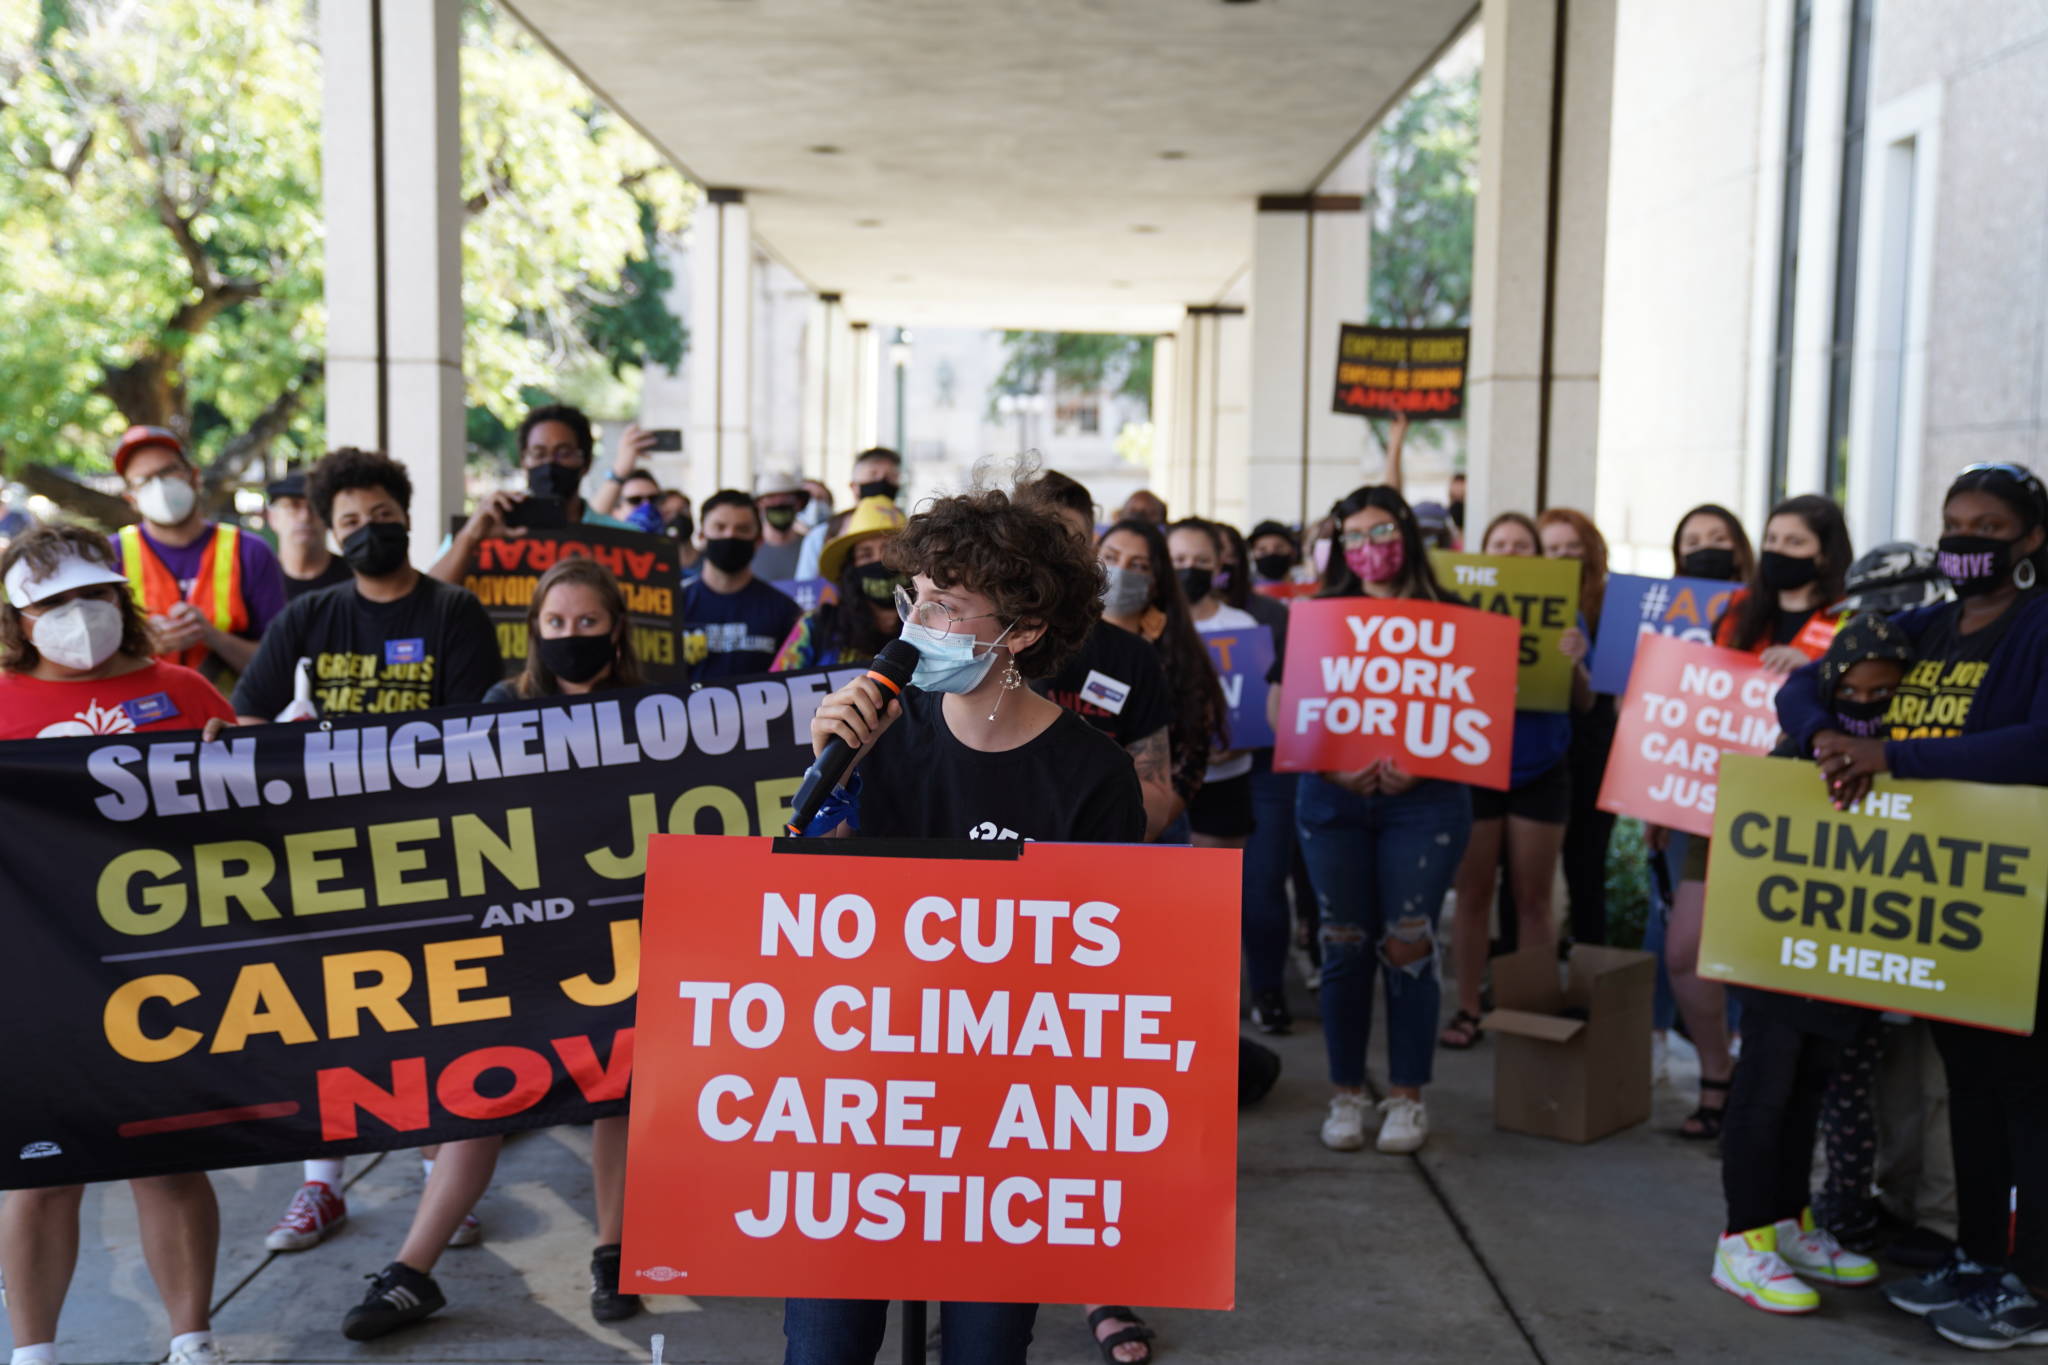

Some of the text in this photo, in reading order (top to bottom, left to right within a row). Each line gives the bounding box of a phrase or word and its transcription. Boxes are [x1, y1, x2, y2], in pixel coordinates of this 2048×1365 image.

[1454, 565, 1498, 586] THE
[1346, 615, 1456, 658] YOU
[1320, 656, 1476, 704] WORK
[1642, 692, 1688, 728] TO
[1679, 664, 1733, 699] NO
[1296, 697, 1492, 766] FOR US
[1641, 732, 1722, 775] CAR
[87, 737, 292, 821] SEN.
[97, 807, 541, 936] GREEN
[1729, 811, 2031, 897] CLIMATE
[480, 898, 575, 929] AND
[760, 892, 1122, 967] NO CUTS
[1757, 875, 1984, 953] CRISIS
[103, 936, 512, 1064] CARE
[1780, 936, 1946, 992] IS HERE.
[679, 981, 1197, 1073] TO CLIMATE,
[697, 1074, 1170, 1160] CARE, AND
[734, 1170, 1122, 1248] JUSTICE!
